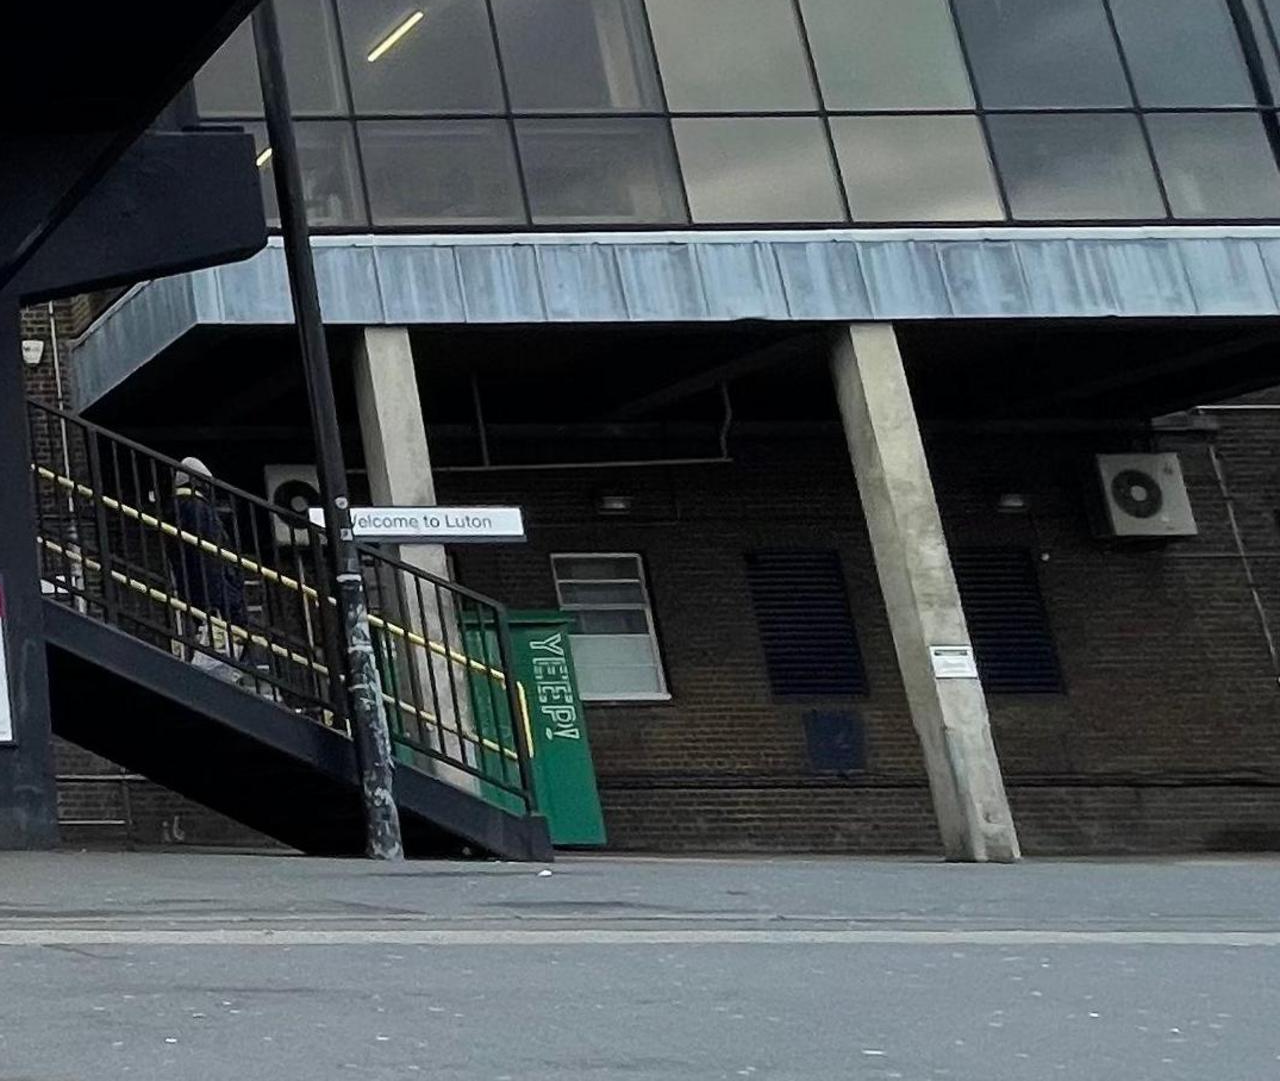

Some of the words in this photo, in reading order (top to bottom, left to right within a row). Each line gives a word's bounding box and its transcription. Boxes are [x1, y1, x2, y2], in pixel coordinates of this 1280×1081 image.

[424, 515, 440, 528] to
[445, 515, 492, 528] Luton
[529, 633, 581, 740] YEEP!
